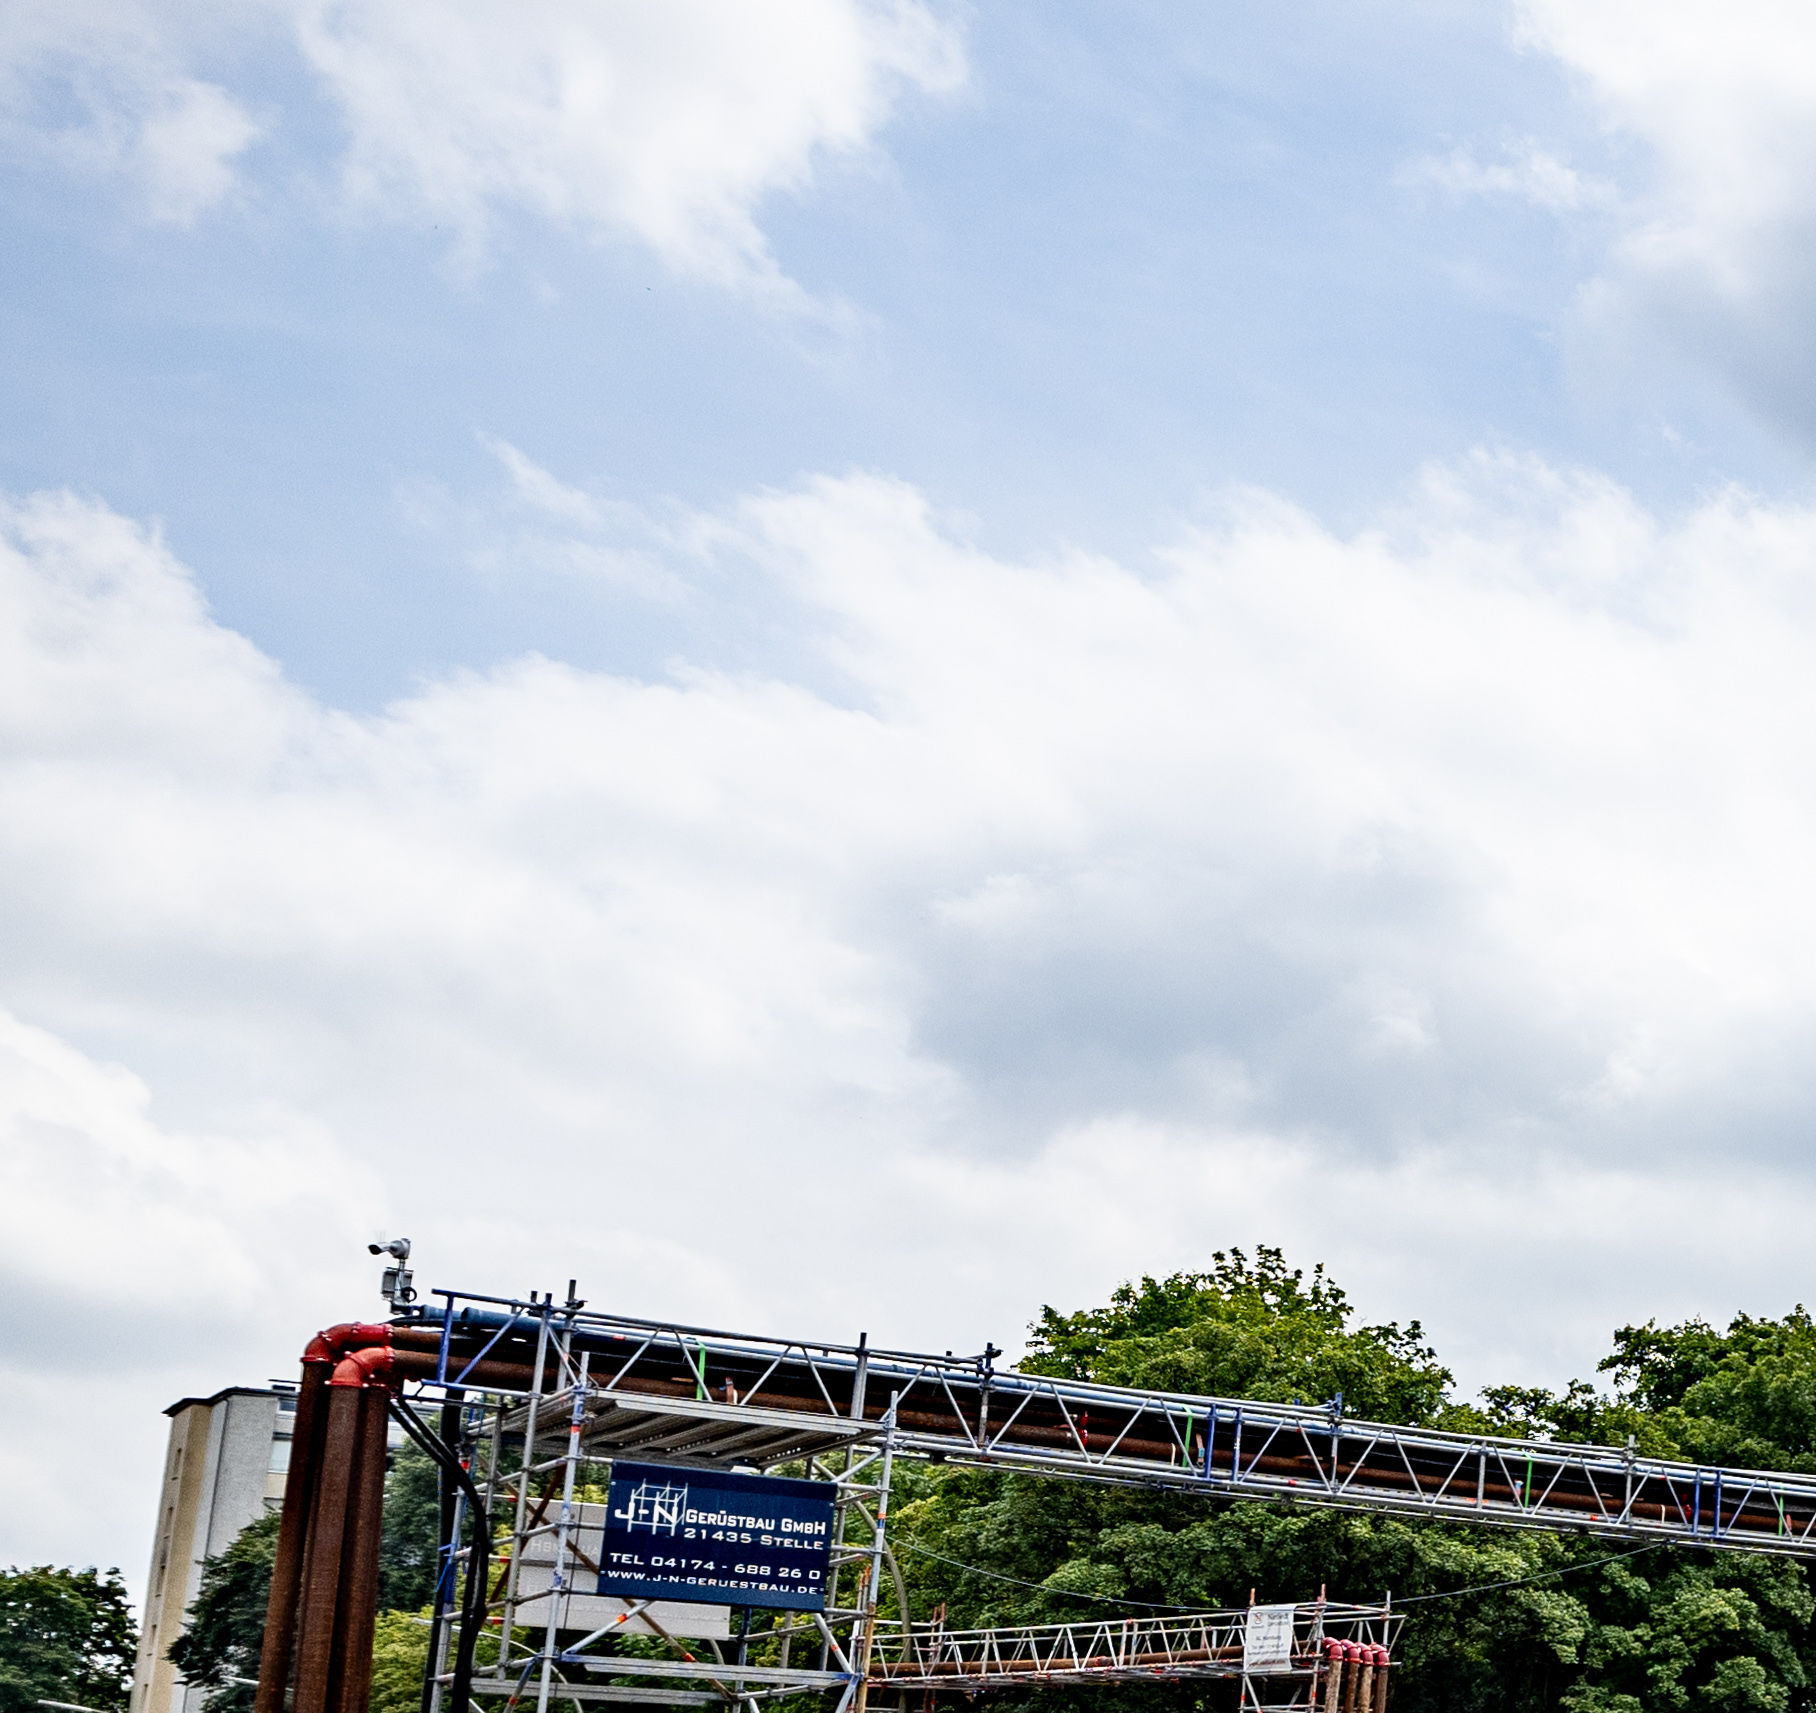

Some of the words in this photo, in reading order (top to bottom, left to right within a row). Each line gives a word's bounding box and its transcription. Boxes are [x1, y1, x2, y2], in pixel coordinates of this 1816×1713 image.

[684, 1527, 752, 1544] 21435
[610, 1552, 645, 1566] TEL
[651, 1556, 715, 1571] 04174
[734, 1563, 771, 1576] 688
[778, 1567, 801, 1578] 26
[808, 1570, 821, 1580] 0
